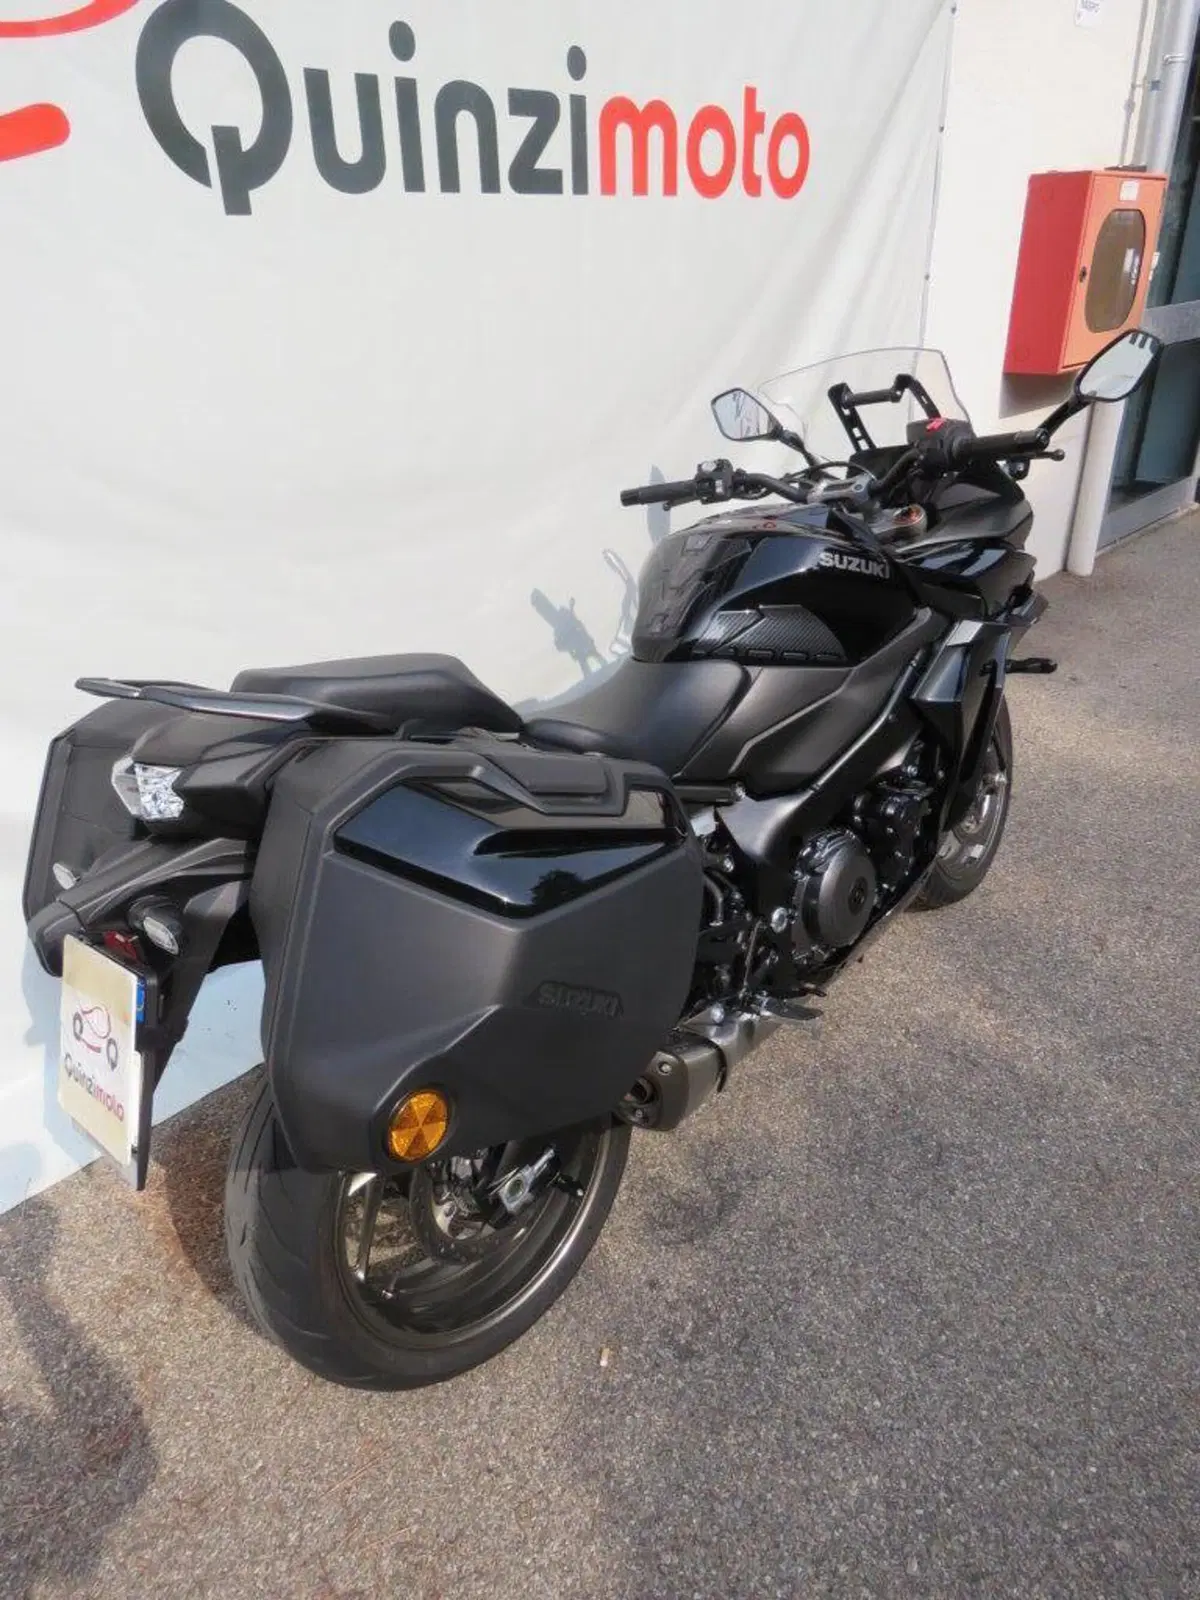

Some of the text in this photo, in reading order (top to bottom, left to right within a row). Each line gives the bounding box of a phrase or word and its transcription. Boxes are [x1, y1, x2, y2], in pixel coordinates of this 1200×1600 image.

[135, 0, 810, 215] Quinzimoto
[819, 551, 890, 579] SUZUKI
[64, 1052, 125, 1122] Quinzimoto
